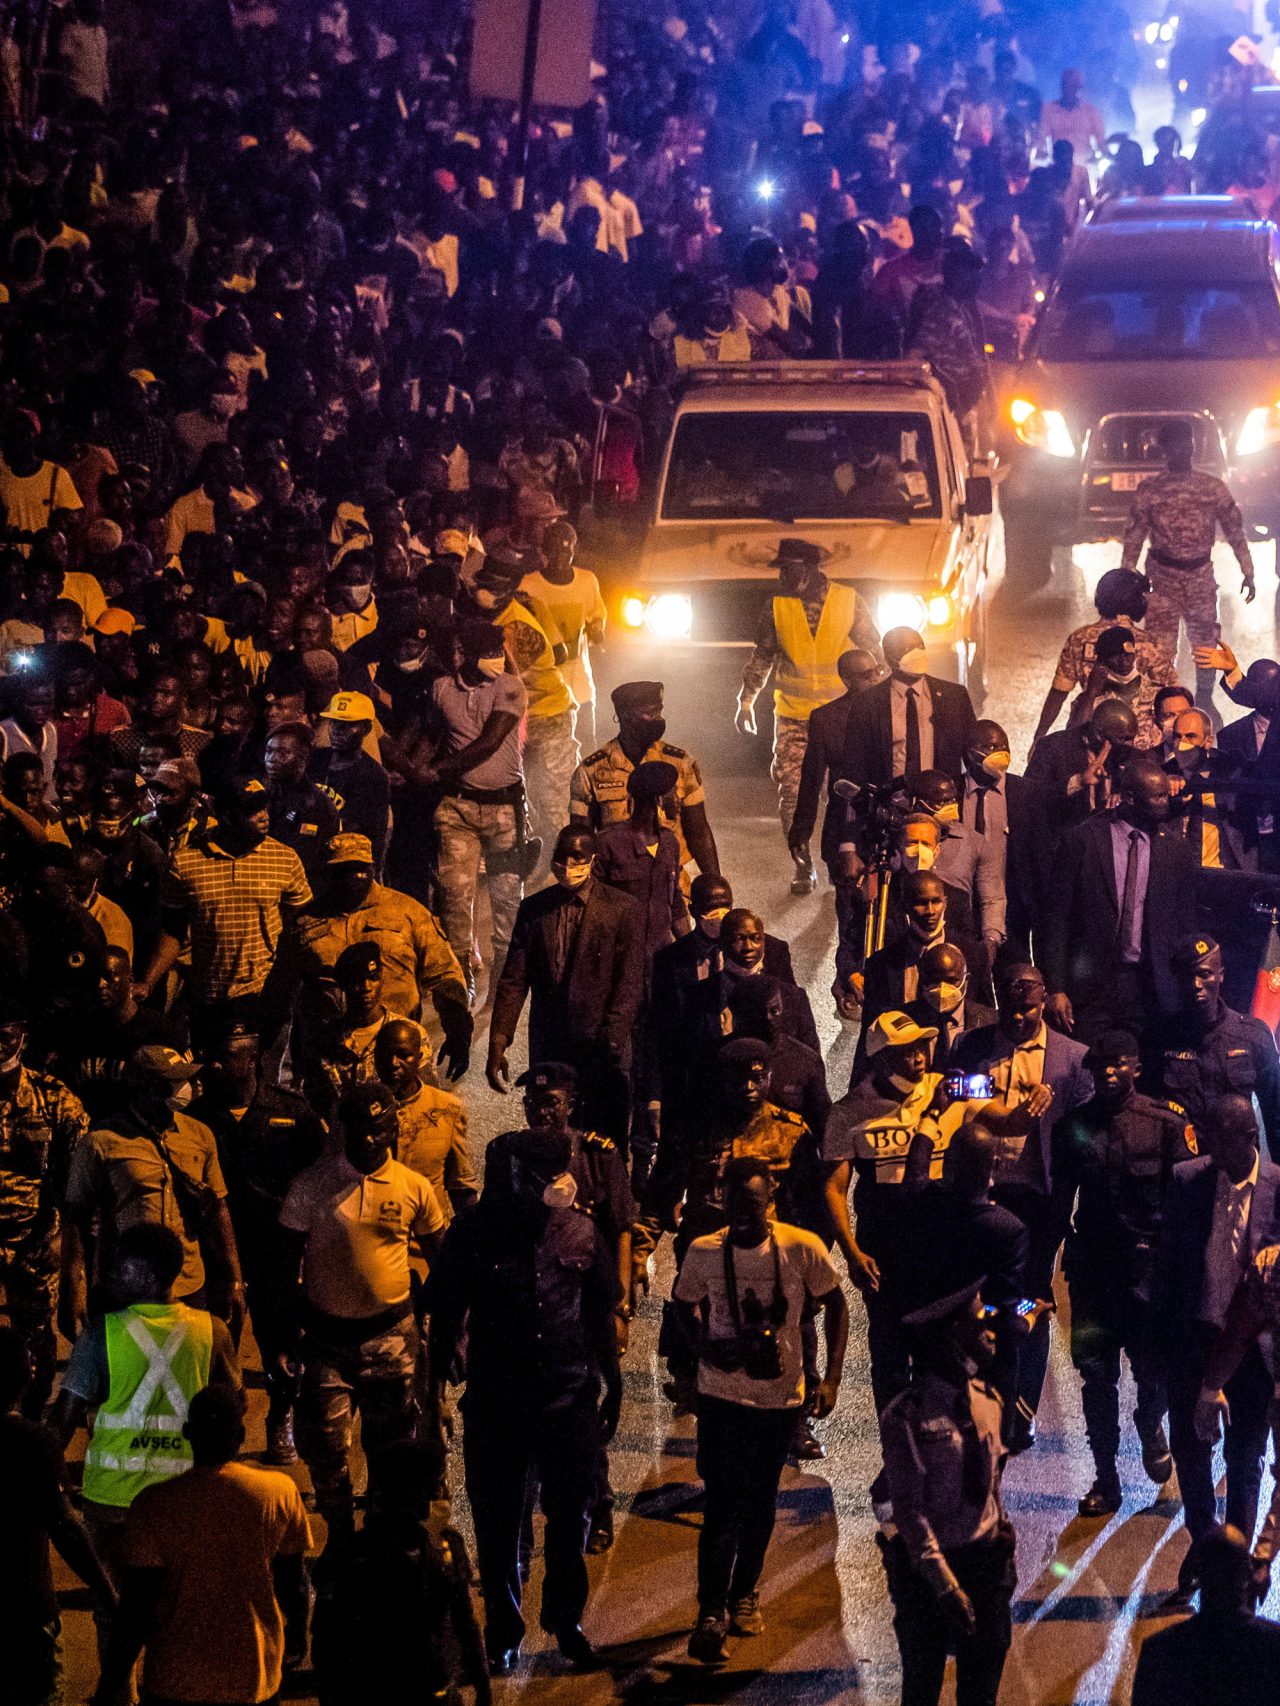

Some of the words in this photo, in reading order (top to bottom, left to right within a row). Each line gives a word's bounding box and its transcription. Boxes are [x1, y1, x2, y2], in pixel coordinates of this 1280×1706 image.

[337, 701, 347, 712] 23
[597, 781, 624, 789] POLICE
[129, 1436, 182, 1450] AVSEC
